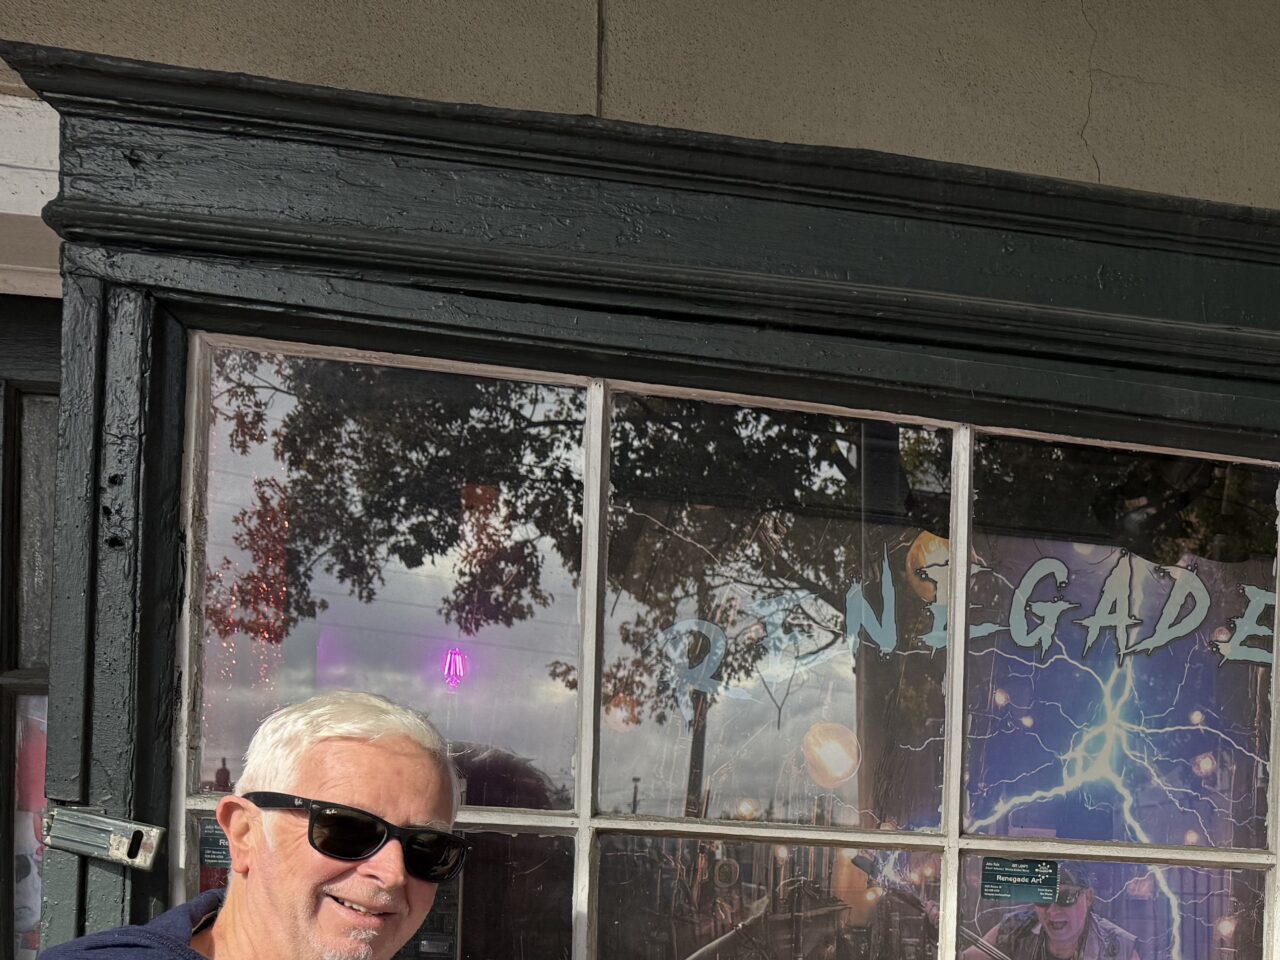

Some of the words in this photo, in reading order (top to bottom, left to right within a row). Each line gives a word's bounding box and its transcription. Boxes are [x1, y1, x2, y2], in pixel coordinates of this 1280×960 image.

[662, 541, 1276, 722] RENEGADE
[996, 874, 1029, 884] Renegade
[1030, 876, 1042, 884] Art
